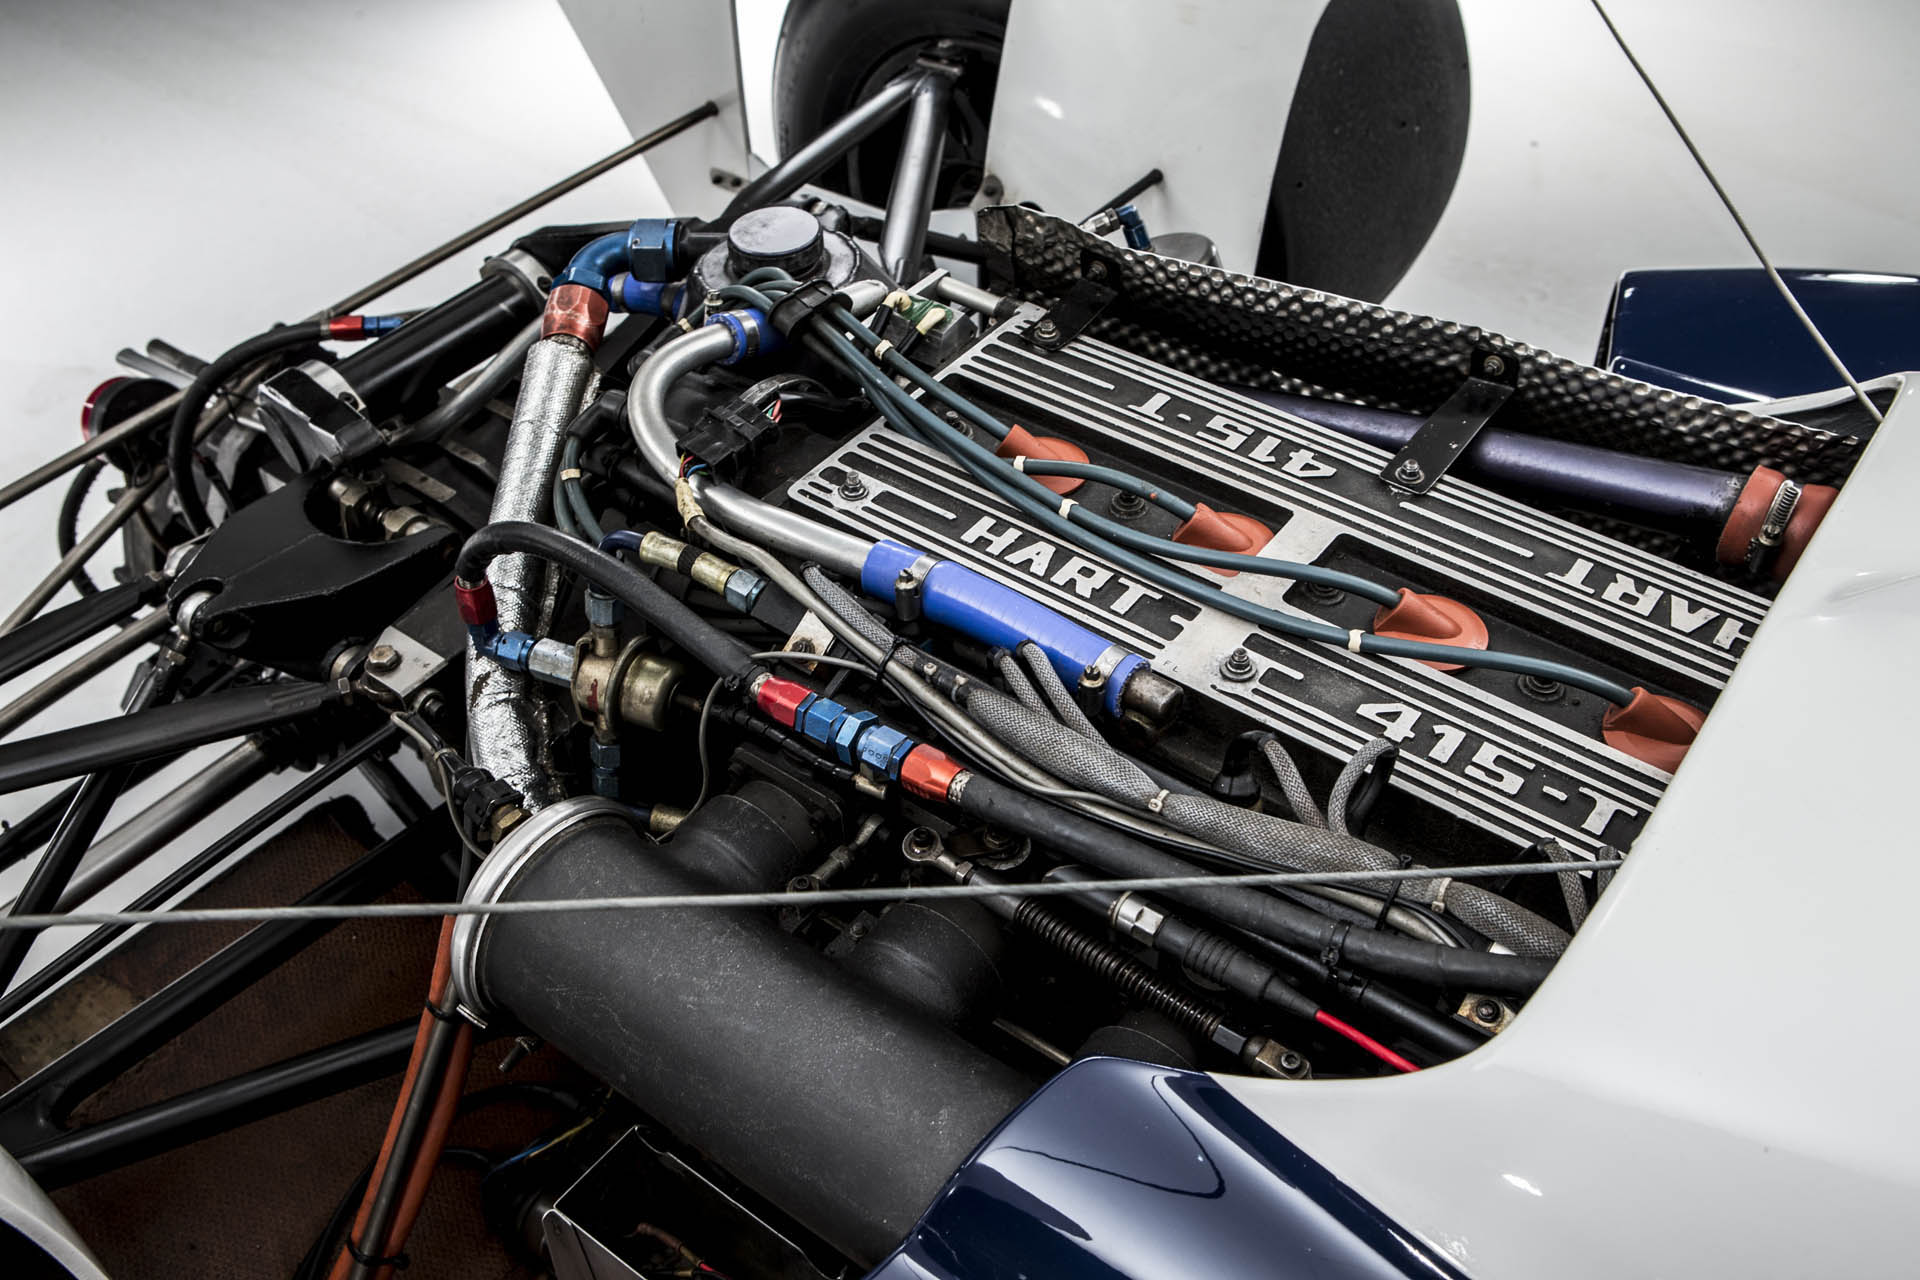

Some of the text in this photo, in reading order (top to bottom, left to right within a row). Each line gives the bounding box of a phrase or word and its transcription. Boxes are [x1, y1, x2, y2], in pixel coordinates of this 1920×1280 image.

[1127, 392, 1337, 478] 415-T
[960, 515, 1638, 836] HART 415-T
